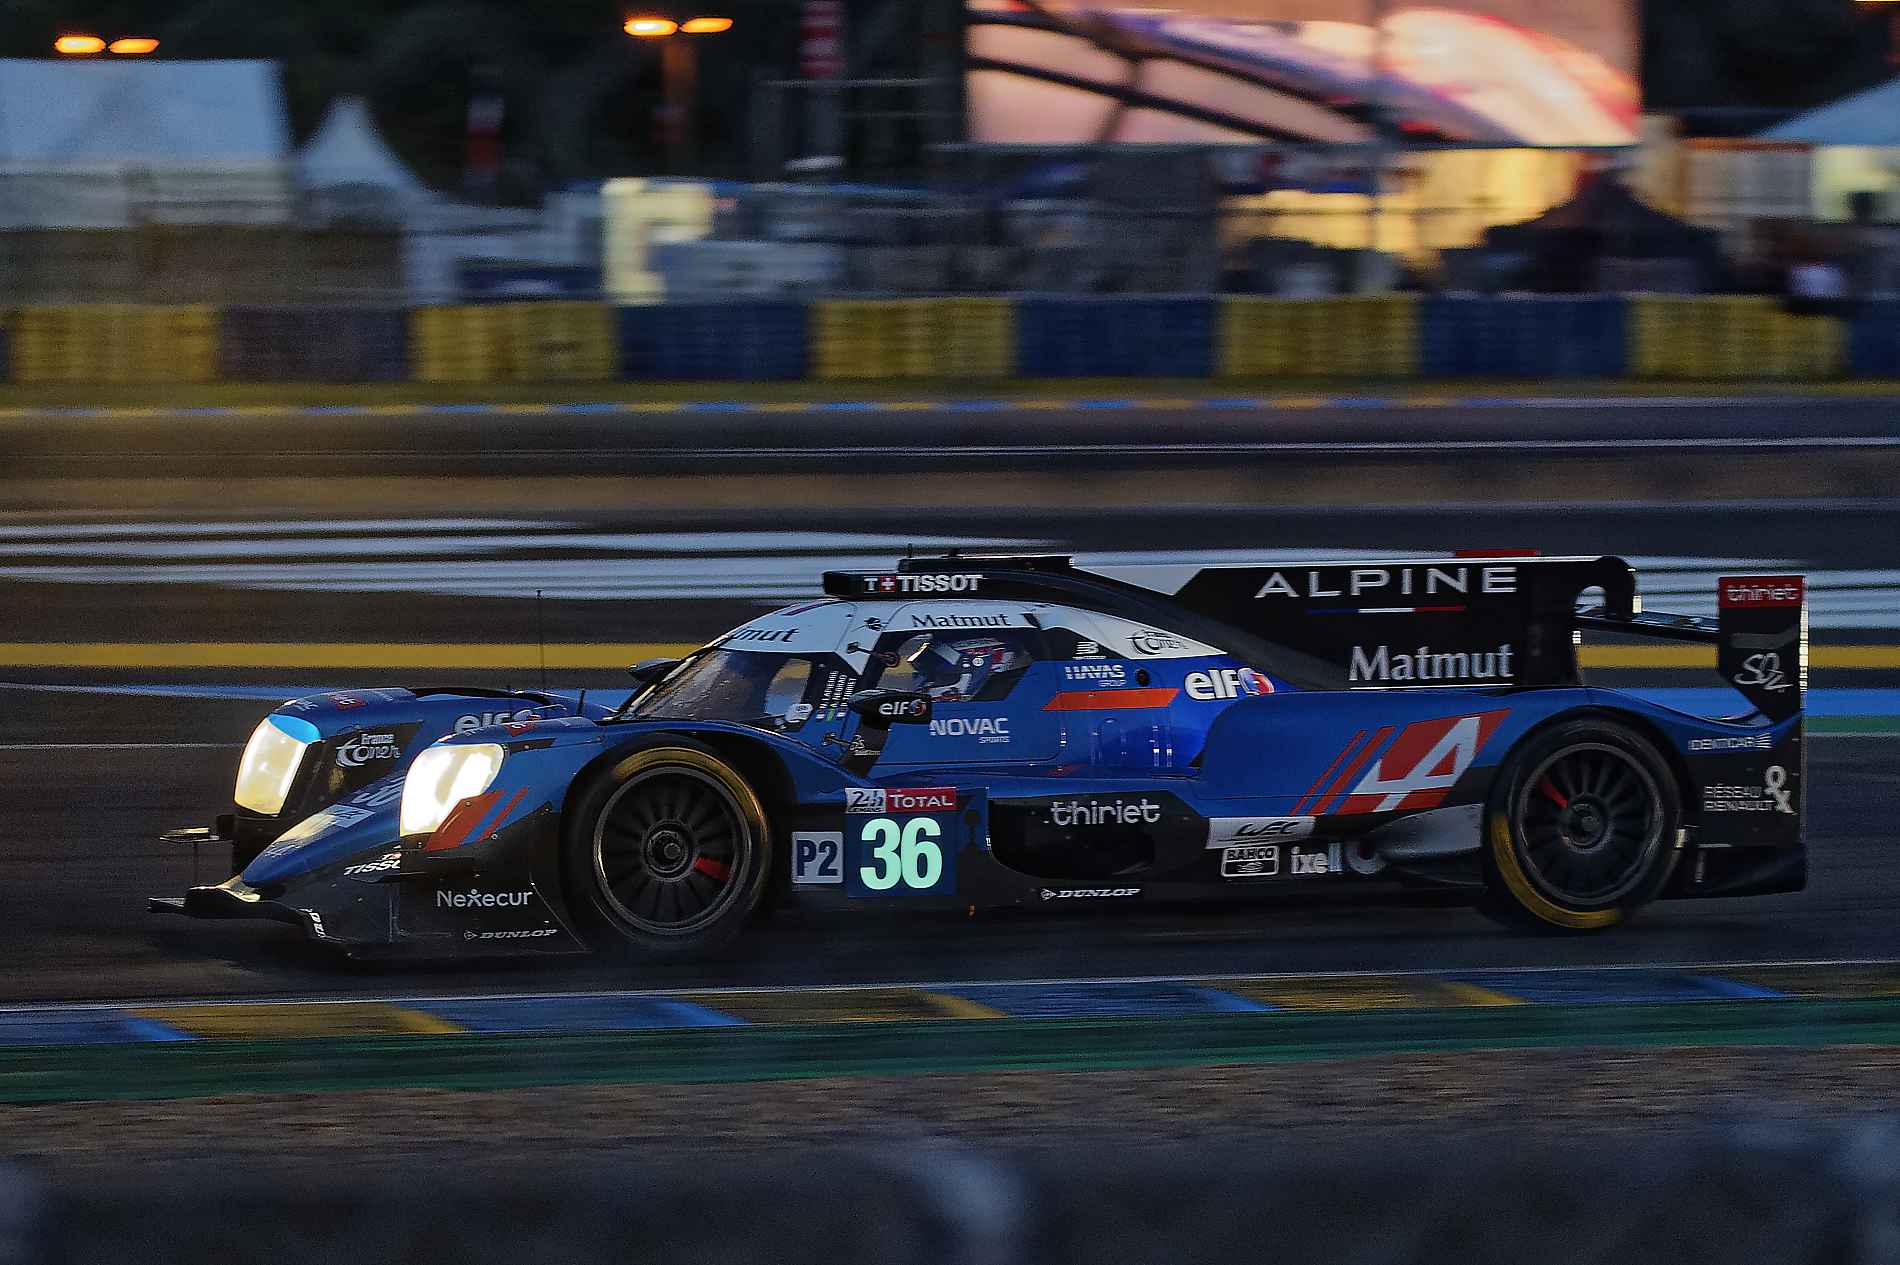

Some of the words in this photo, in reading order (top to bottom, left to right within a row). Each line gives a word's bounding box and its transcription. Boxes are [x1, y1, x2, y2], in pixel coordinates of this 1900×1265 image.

[896, 575, 984, 592] TISSOT
[1255, 567, 1518, 599] ALPINE
[911, 613, 1012, 628] Matmut
[1348, 643, 1514, 682] Matmut
[879, 701, 910, 716] elf
[928, 717, 1010, 737] NOVAC
[888, 793, 954, 809] TOTAL
[1051, 798, 1161, 826] thiriet
[796, 839, 838, 877] P2
[860, 817, 943, 890] 36
[436, 888, 534, 908] Nexecur
[1056, 888, 1142, 899] DUNLOP
[478, 928, 558, 939] DUNLOP
